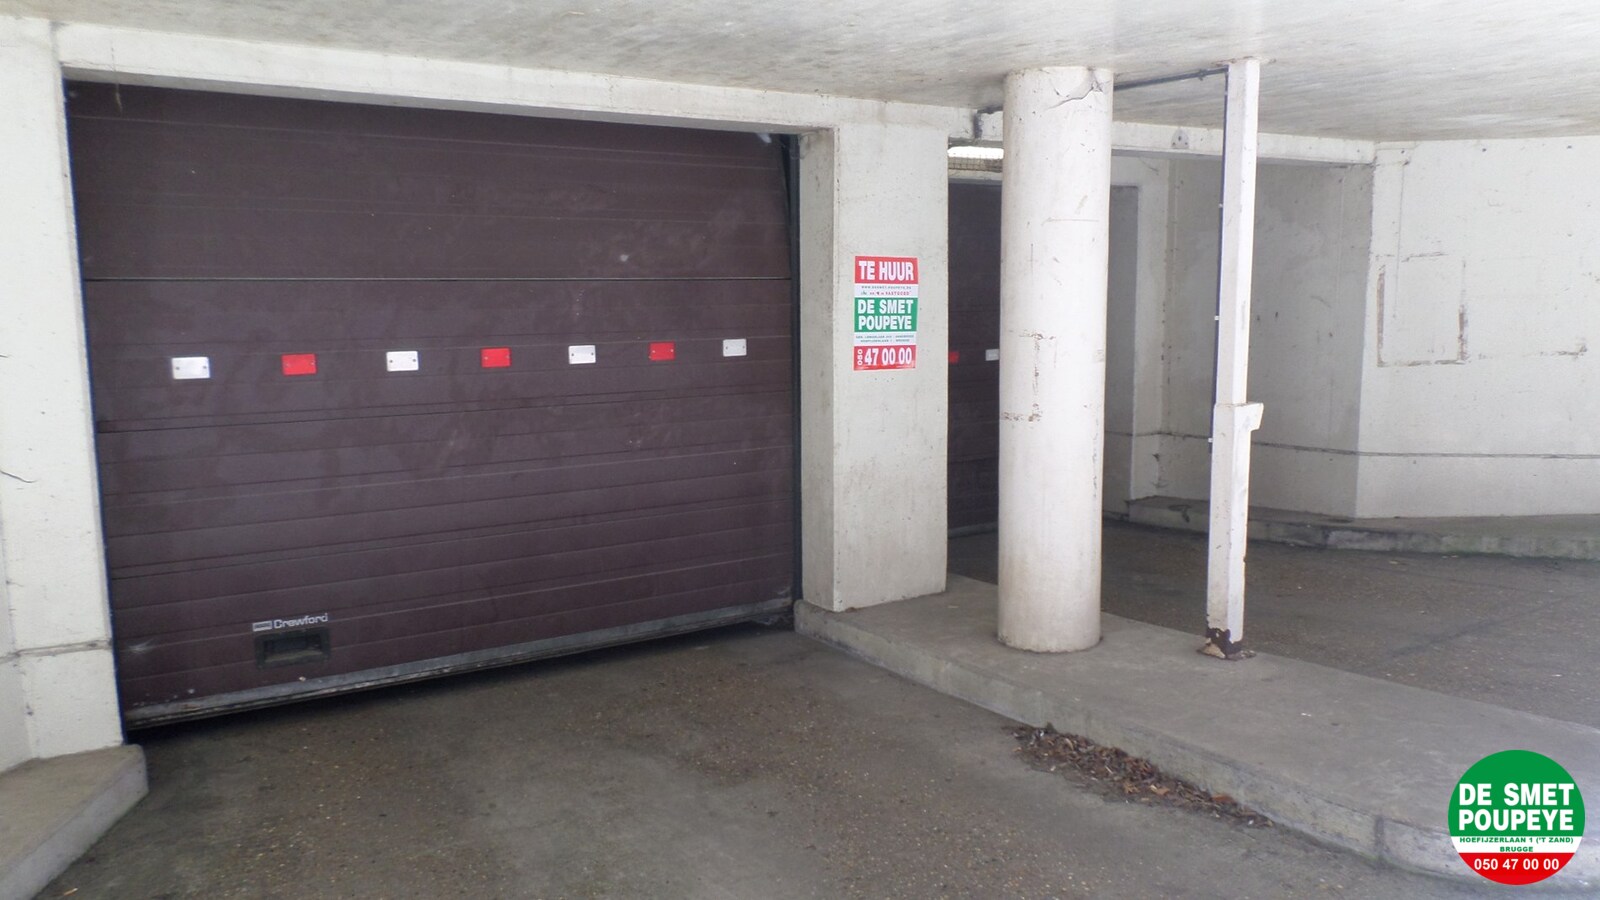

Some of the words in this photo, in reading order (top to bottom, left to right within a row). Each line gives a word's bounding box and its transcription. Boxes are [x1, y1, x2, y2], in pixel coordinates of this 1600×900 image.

[858, 260, 876, 280] TE
[879, 261, 915, 281] HUUR
[857, 299, 875, 314] DE
[879, 299, 914, 314] SMET
[858, 315, 912, 331] POUPEYE
[864, 348, 879, 366] 47
[881, 348, 896, 366] 00
[898, 347, 912, 365] 00
